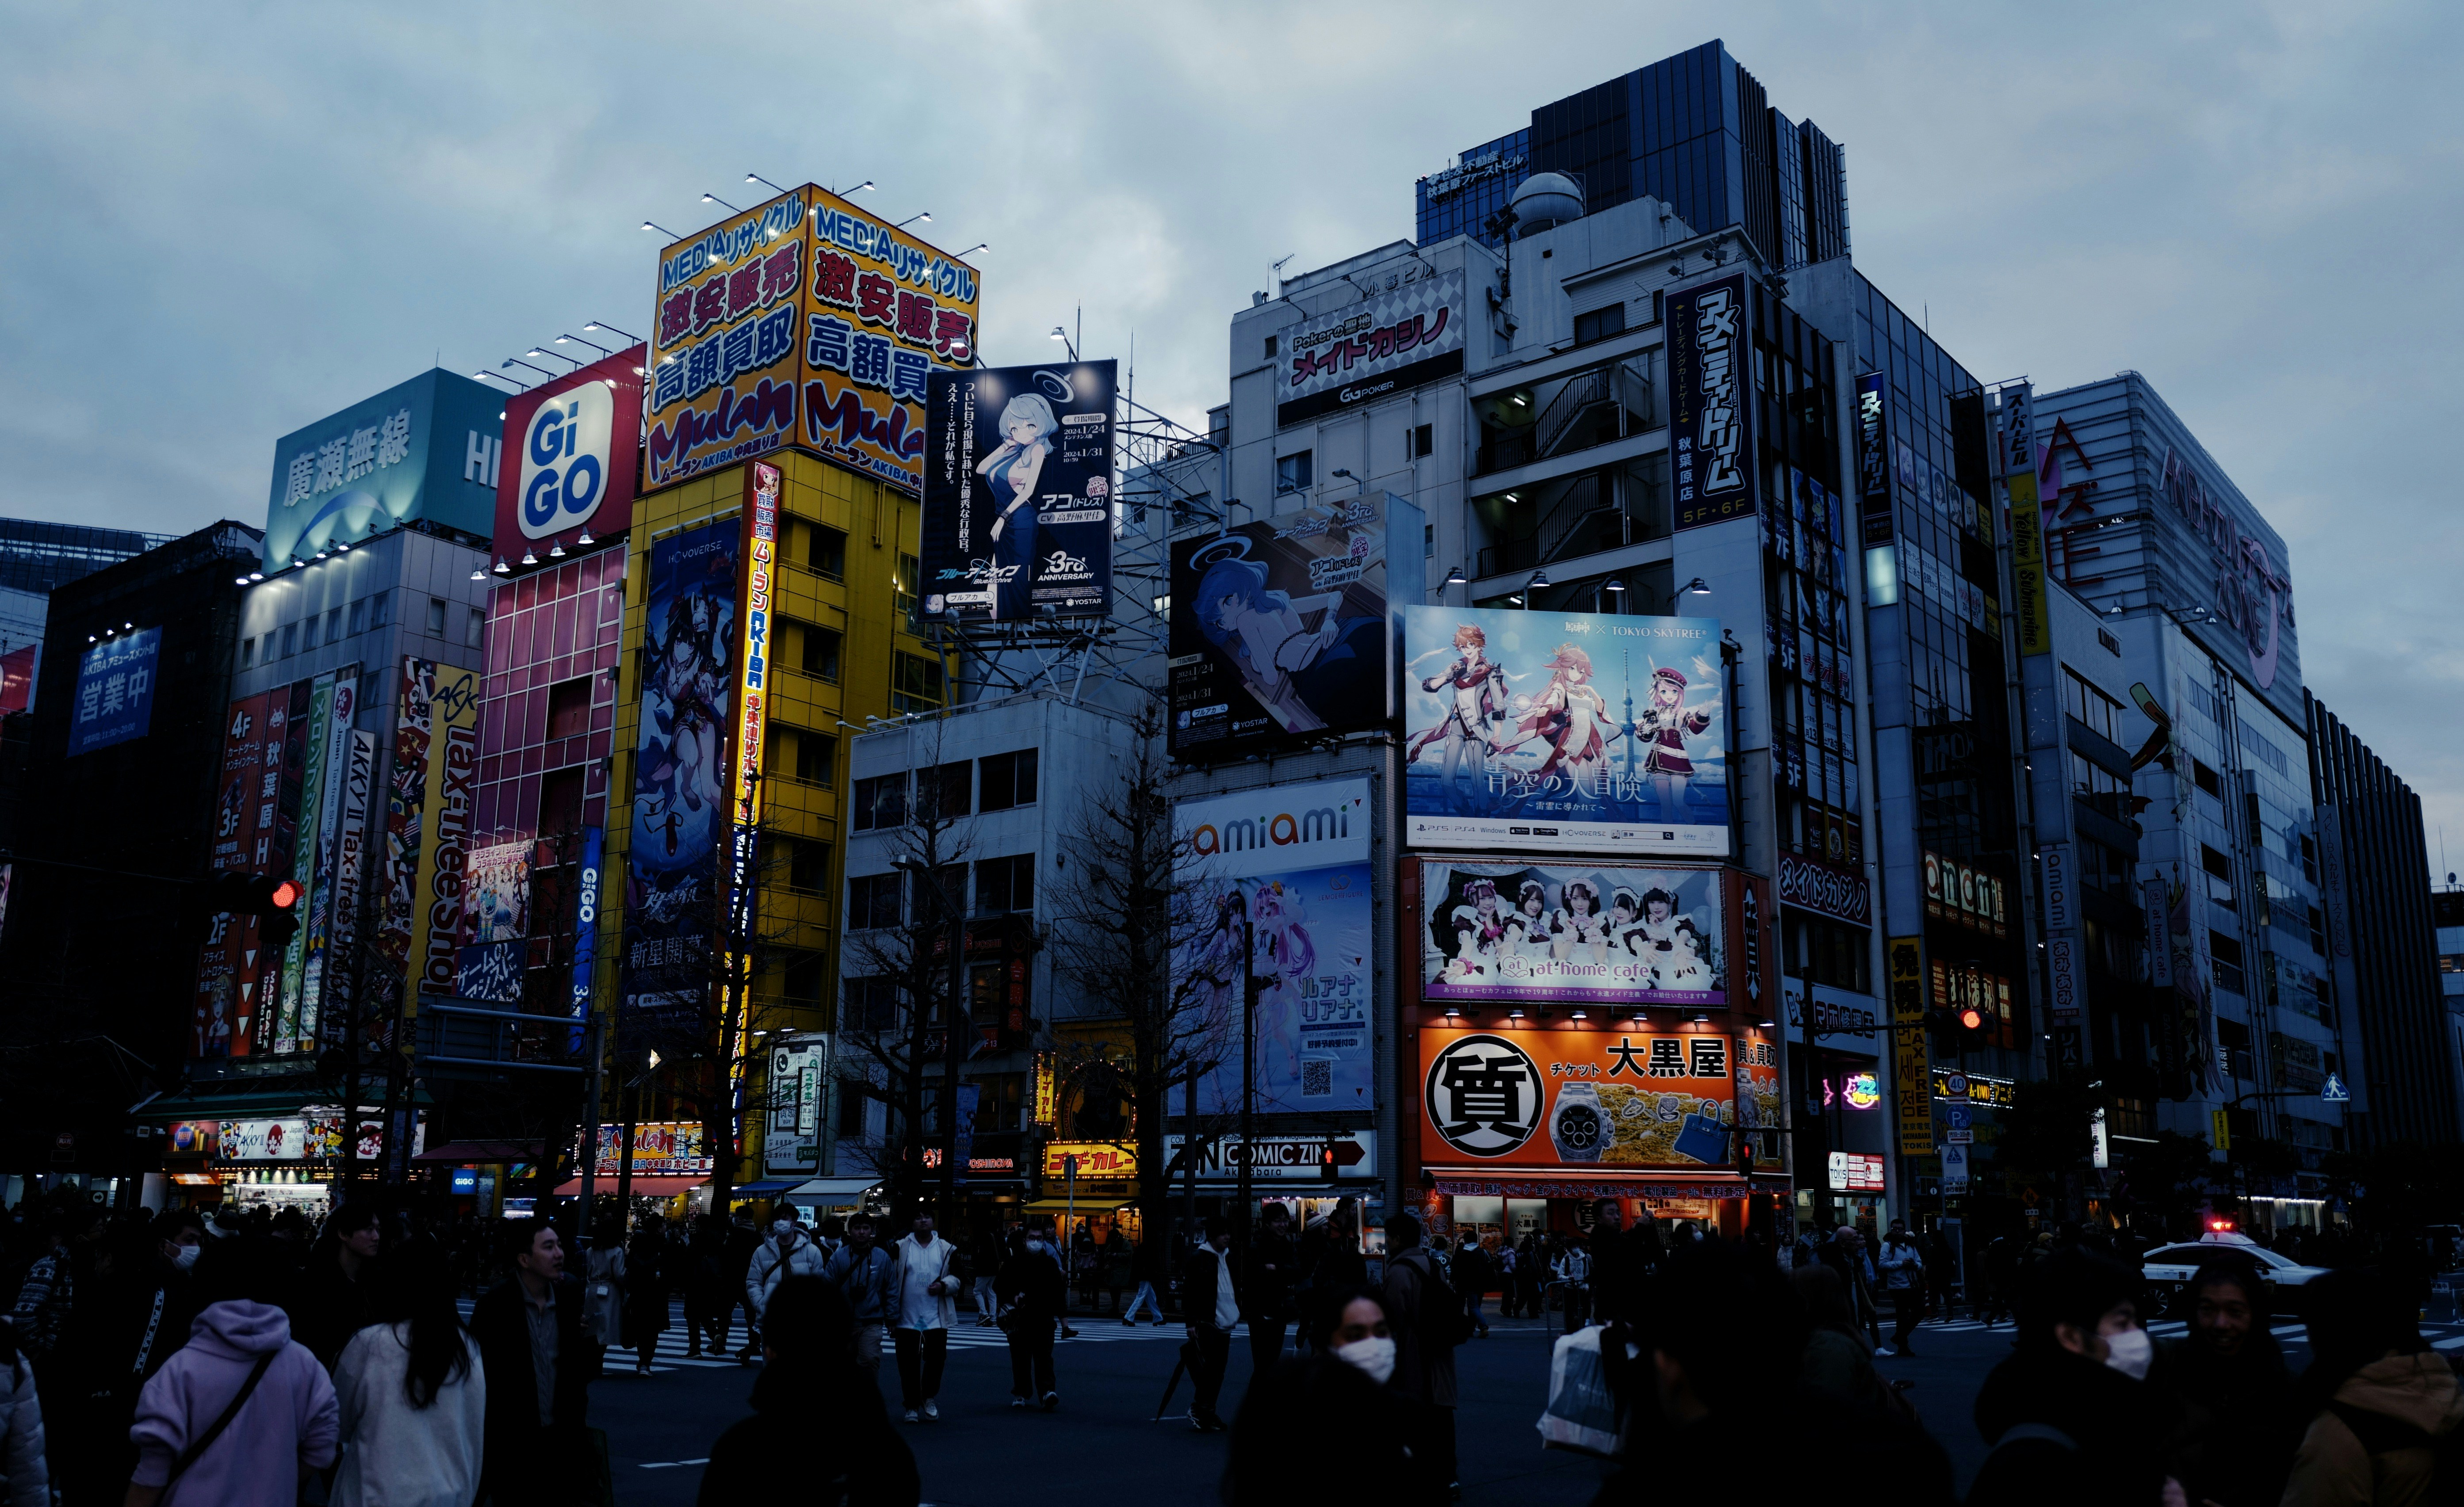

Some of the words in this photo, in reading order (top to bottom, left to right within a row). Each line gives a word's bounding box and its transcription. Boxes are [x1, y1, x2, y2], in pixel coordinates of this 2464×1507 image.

[1427, 154, 1524, 199] 秋葉原ファーストビル
[1442, 150, 1500, 180] 住友不動産
[662, 193, 806, 294] MEDIAリサイクル
[815, 202, 975, 303] MEDIAリサイクル
[659, 239, 801, 349] 激安販売
[812, 246, 974, 360] 激安販売
[651, 302, 795, 415] 高額買取
[1291, 307, 1449, 386] メイドカジノ
[1676, 311, 1690, 417] トレーディングカードゲーム
[1695, 287, 1746, 497] アメニティドリーム
[531, 401, 579, 467] Gi
[649, 377, 793, 484] Mulan
[1064, 425, 1105, 435] 2024.1/24
[2007, 393, 2028, 467] スーパービル
[283, 408, 411, 507] 廣瀬無線
[1064, 447, 1103, 458] 2024.1/31
[1678, 437, 1694, 501] 秋葉原店
[524, 454, 601, 527] GO
[757, 493, 774, 509] 買取
[756, 508, 773, 524] 販売
[1057, 511, 1100, 522] 高野麻里佳
[1341, 515, 1380, 529] ANNIVERSARY
[754, 524, 773, 541] 市場
[1775, 532, 1790, 560] 7F
[2012, 511, 2031, 559] Yellow
[669, 540, 722, 565] HOYOVERSE
[1037, 572, 1094, 581] ANNIVERSARY
[2018, 568, 2038, 648] Submarine
[1612, 627, 1650, 637] TOKYO
[83, 659, 107, 677] AKIBA
[1177, 663, 1213, 678] 2024.1/24
[80, 666, 149, 724] 営業中
[1176, 687, 1211, 702] 2024.1/31
[231, 710, 252, 740] 4F
[1195, 707, 1217, 717] ブルアカ
[1240, 717, 1268, 728] YOSTAR
[226, 756, 259, 771] オンラインゲーム
[228, 740, 260, 758] カードゲーム
[1482, 761, 1647, 802] 青空の大冒険
[218, 808, 240, 837] 3F
[1193, 805, 1348, 856] amiami
[580, 867, 597, 923] GiGO
[1779, 857, 1867, 919] メイドカジノ
[2047, 854, 2066, 927] amiami
[207, 915, 228, 945] 2F
[200, 963, 234, 978] レトロゲーム
[1613, 961, 1649, 978] cafe
[1892, 943, 1923, 1014] 免税
[2053, 941, 2073, 1006] あみあみ
[199, 980, 227, 993] 音楽ゲーム
[267, 971, 276, 1006] MAD
[1301, 975, 1356, 999] ルアナ
[1301, 998, 1356, 1022] リアナ
[263, 1009, 272, 1049] CATZ
[1911, 1021, 1925, 1059] TAX
[1551, 1063, 1600, 1077] チケット
[1606, 1038, 1728, 1079] 大黒屋
[1442, 1051, 1533, 1142] 質
[1914, 1068, 1929, 1118] FREE
[1950, 1078, 1965, 1089] 40
[1902, 1122, 1931, 1131] 東京電気
[1951, 1111, 1962, 1127] P
[1436, 1181, 1481, 1195] 高価買取
[1702, 1186, 1747, 1198] 無料査定
[1515, 1219, 1540, 1228] 大黒屋
